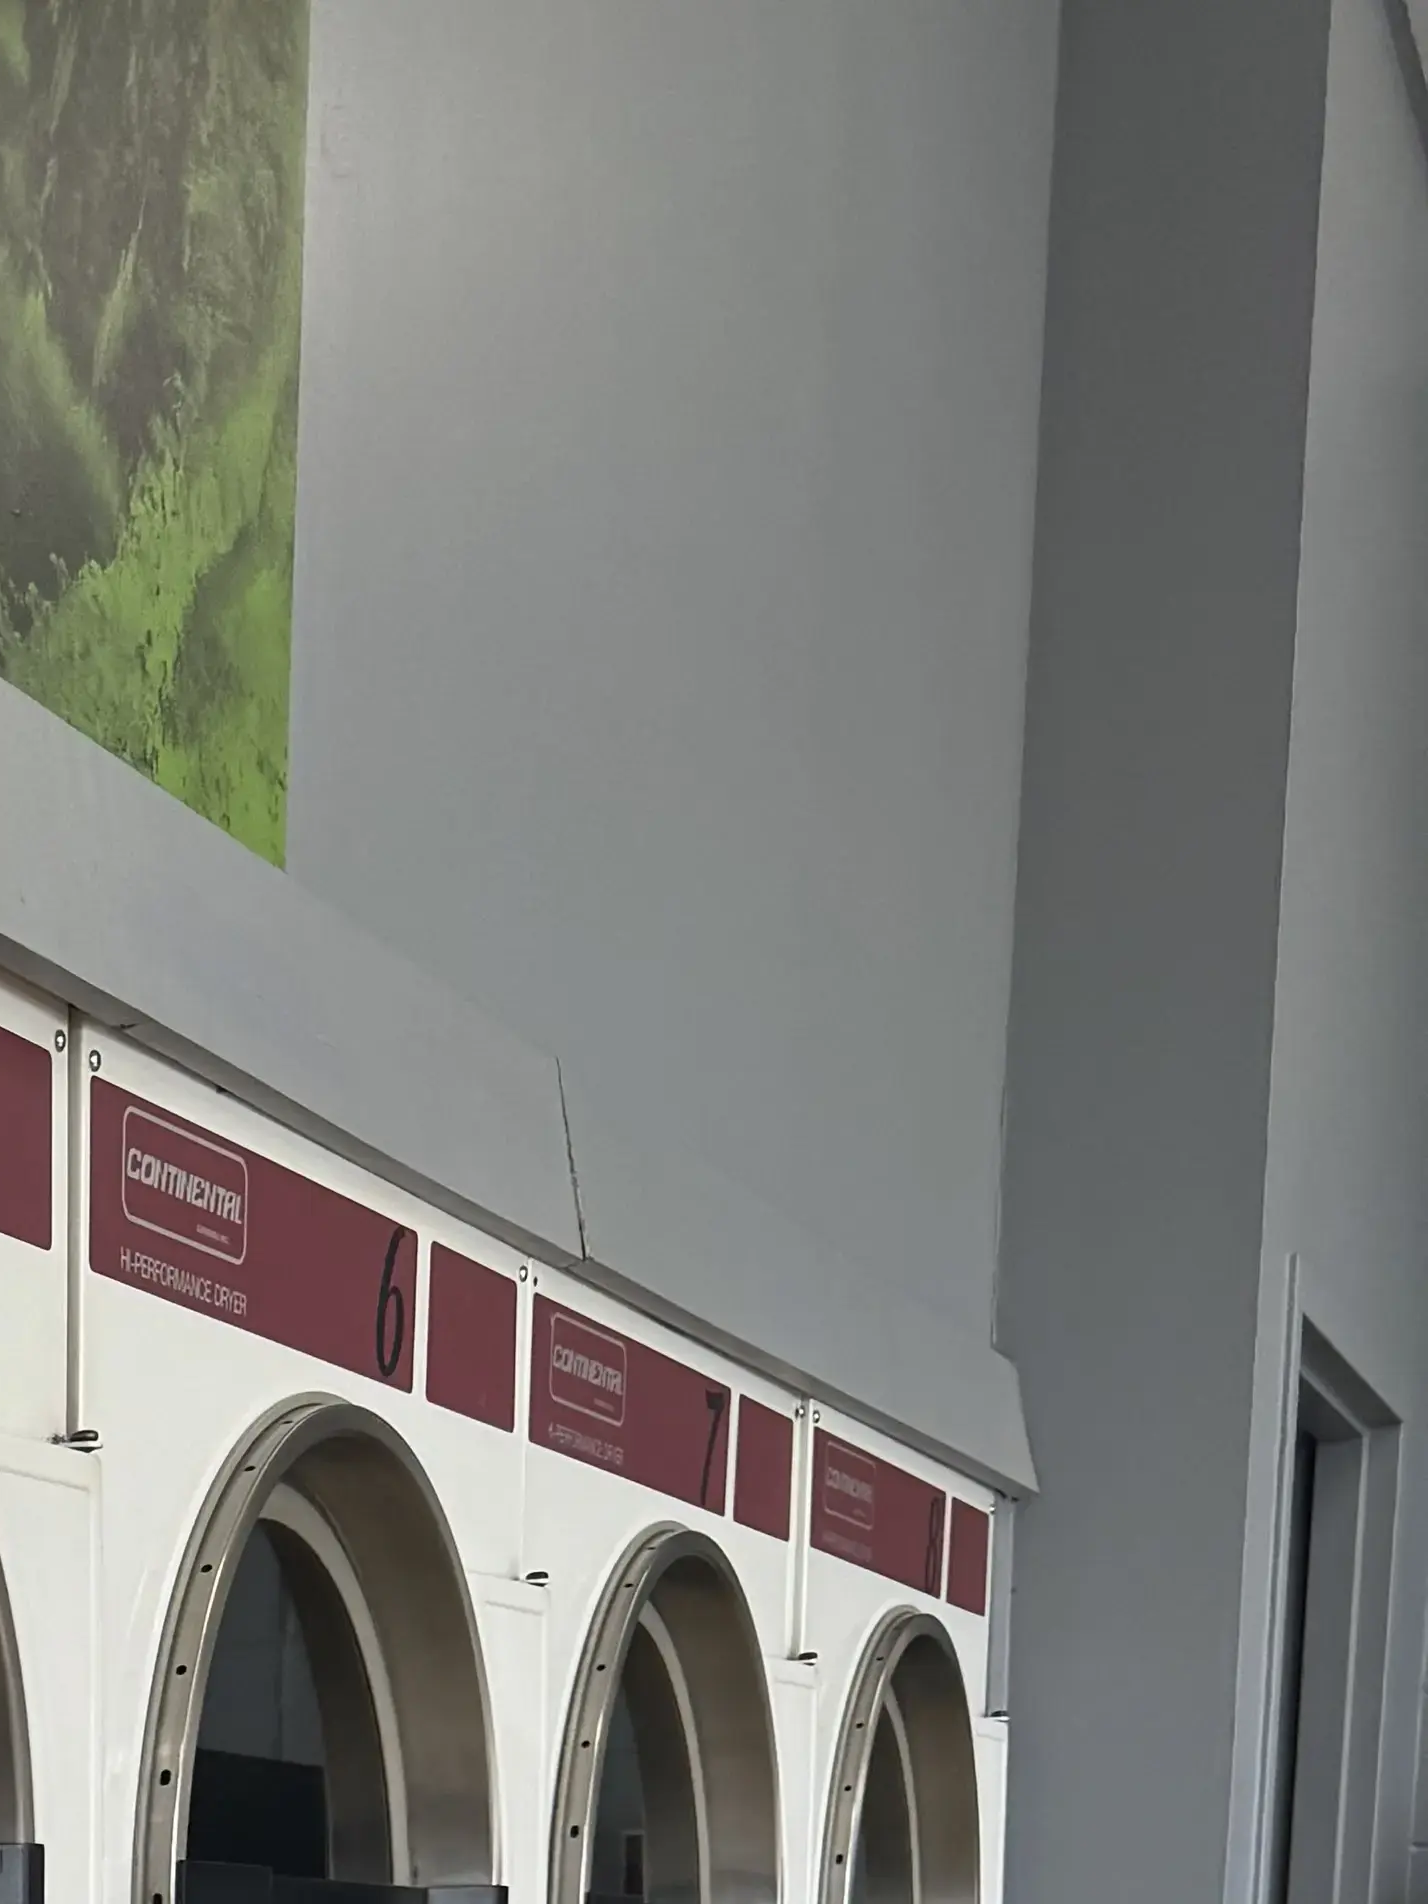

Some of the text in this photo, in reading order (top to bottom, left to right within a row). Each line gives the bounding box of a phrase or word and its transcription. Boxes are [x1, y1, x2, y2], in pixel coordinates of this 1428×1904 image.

[126, 1147, 243, 1226] CONTINENTAL
[120, 1246, 248, 1317] HI-PERFORMANCE DRYER
[375, 1224, 406, 1378] 6
[699, 1388, 726, 1507] 7
[925, 1494, 943, 1594] 8
